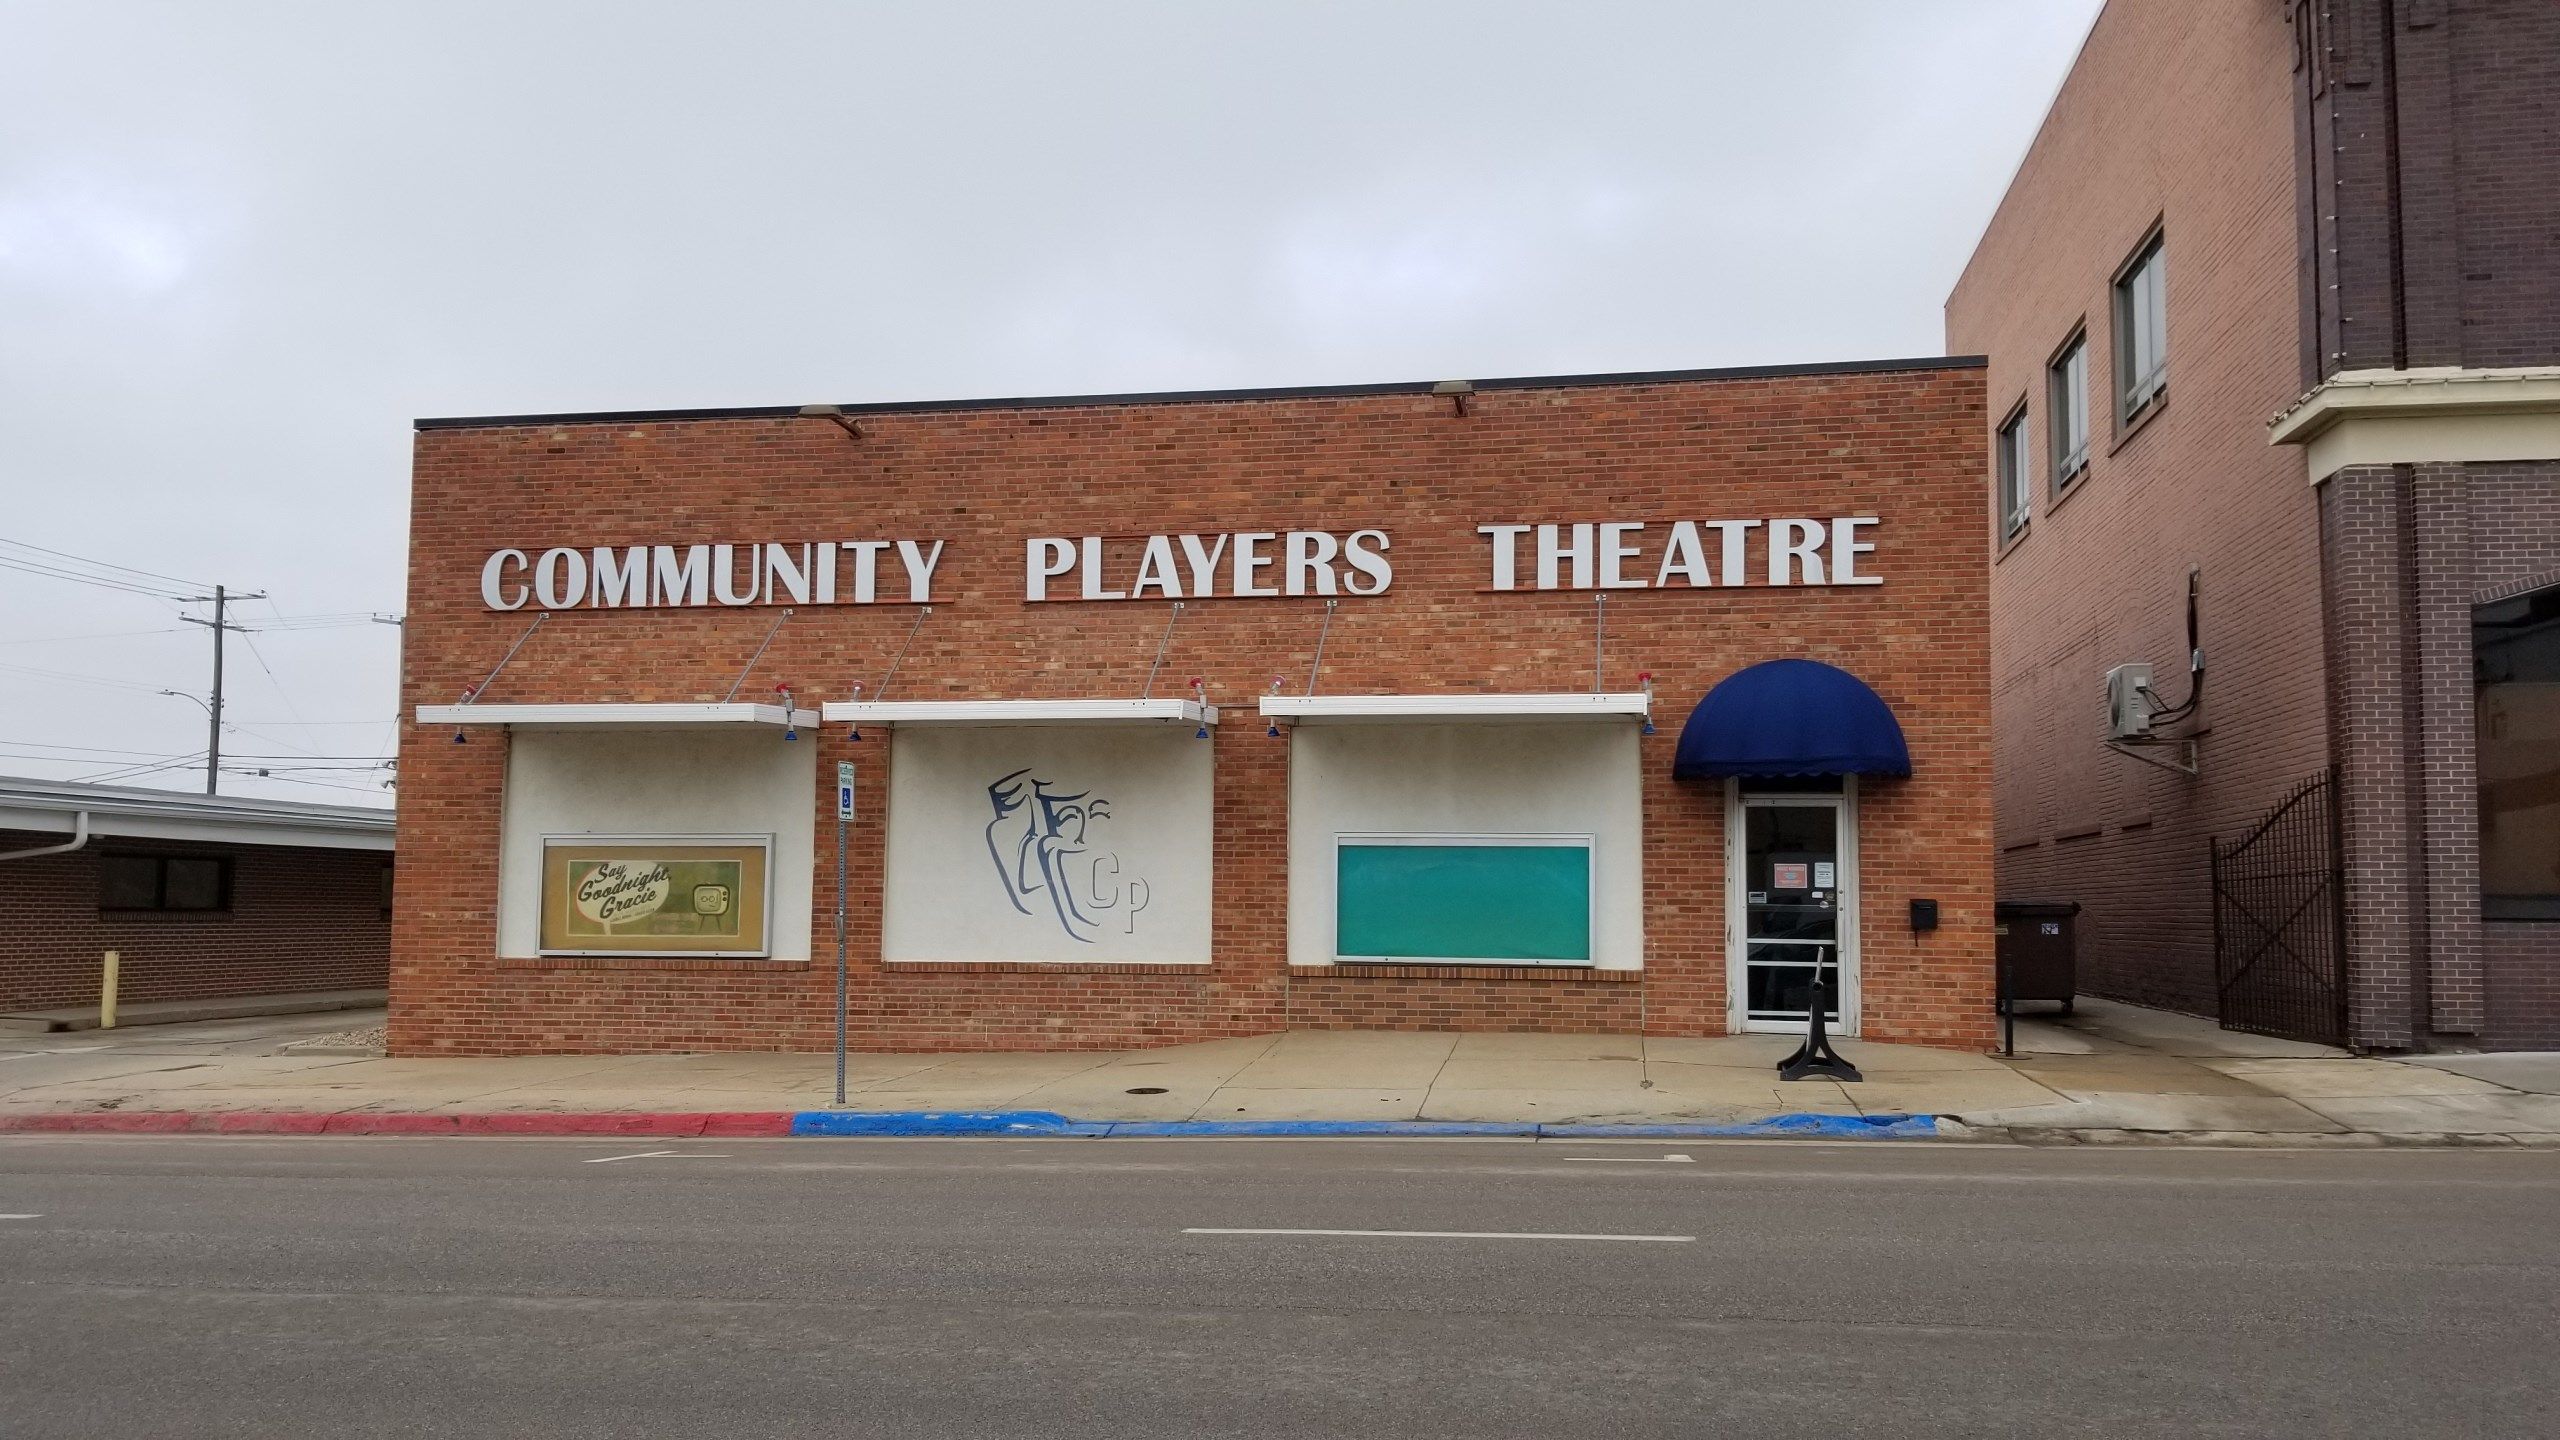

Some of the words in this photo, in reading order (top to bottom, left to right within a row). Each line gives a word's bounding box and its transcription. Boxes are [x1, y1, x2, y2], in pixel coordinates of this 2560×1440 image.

[481, 540, 944, 610] COMMUNITY
[1026, 530, 1393, 600] PLAYERS
[1478, 517, 1884, 590] THEATRE
[595, 863, 627, 883] Say
[600, 887, 657, 919] Gracie
